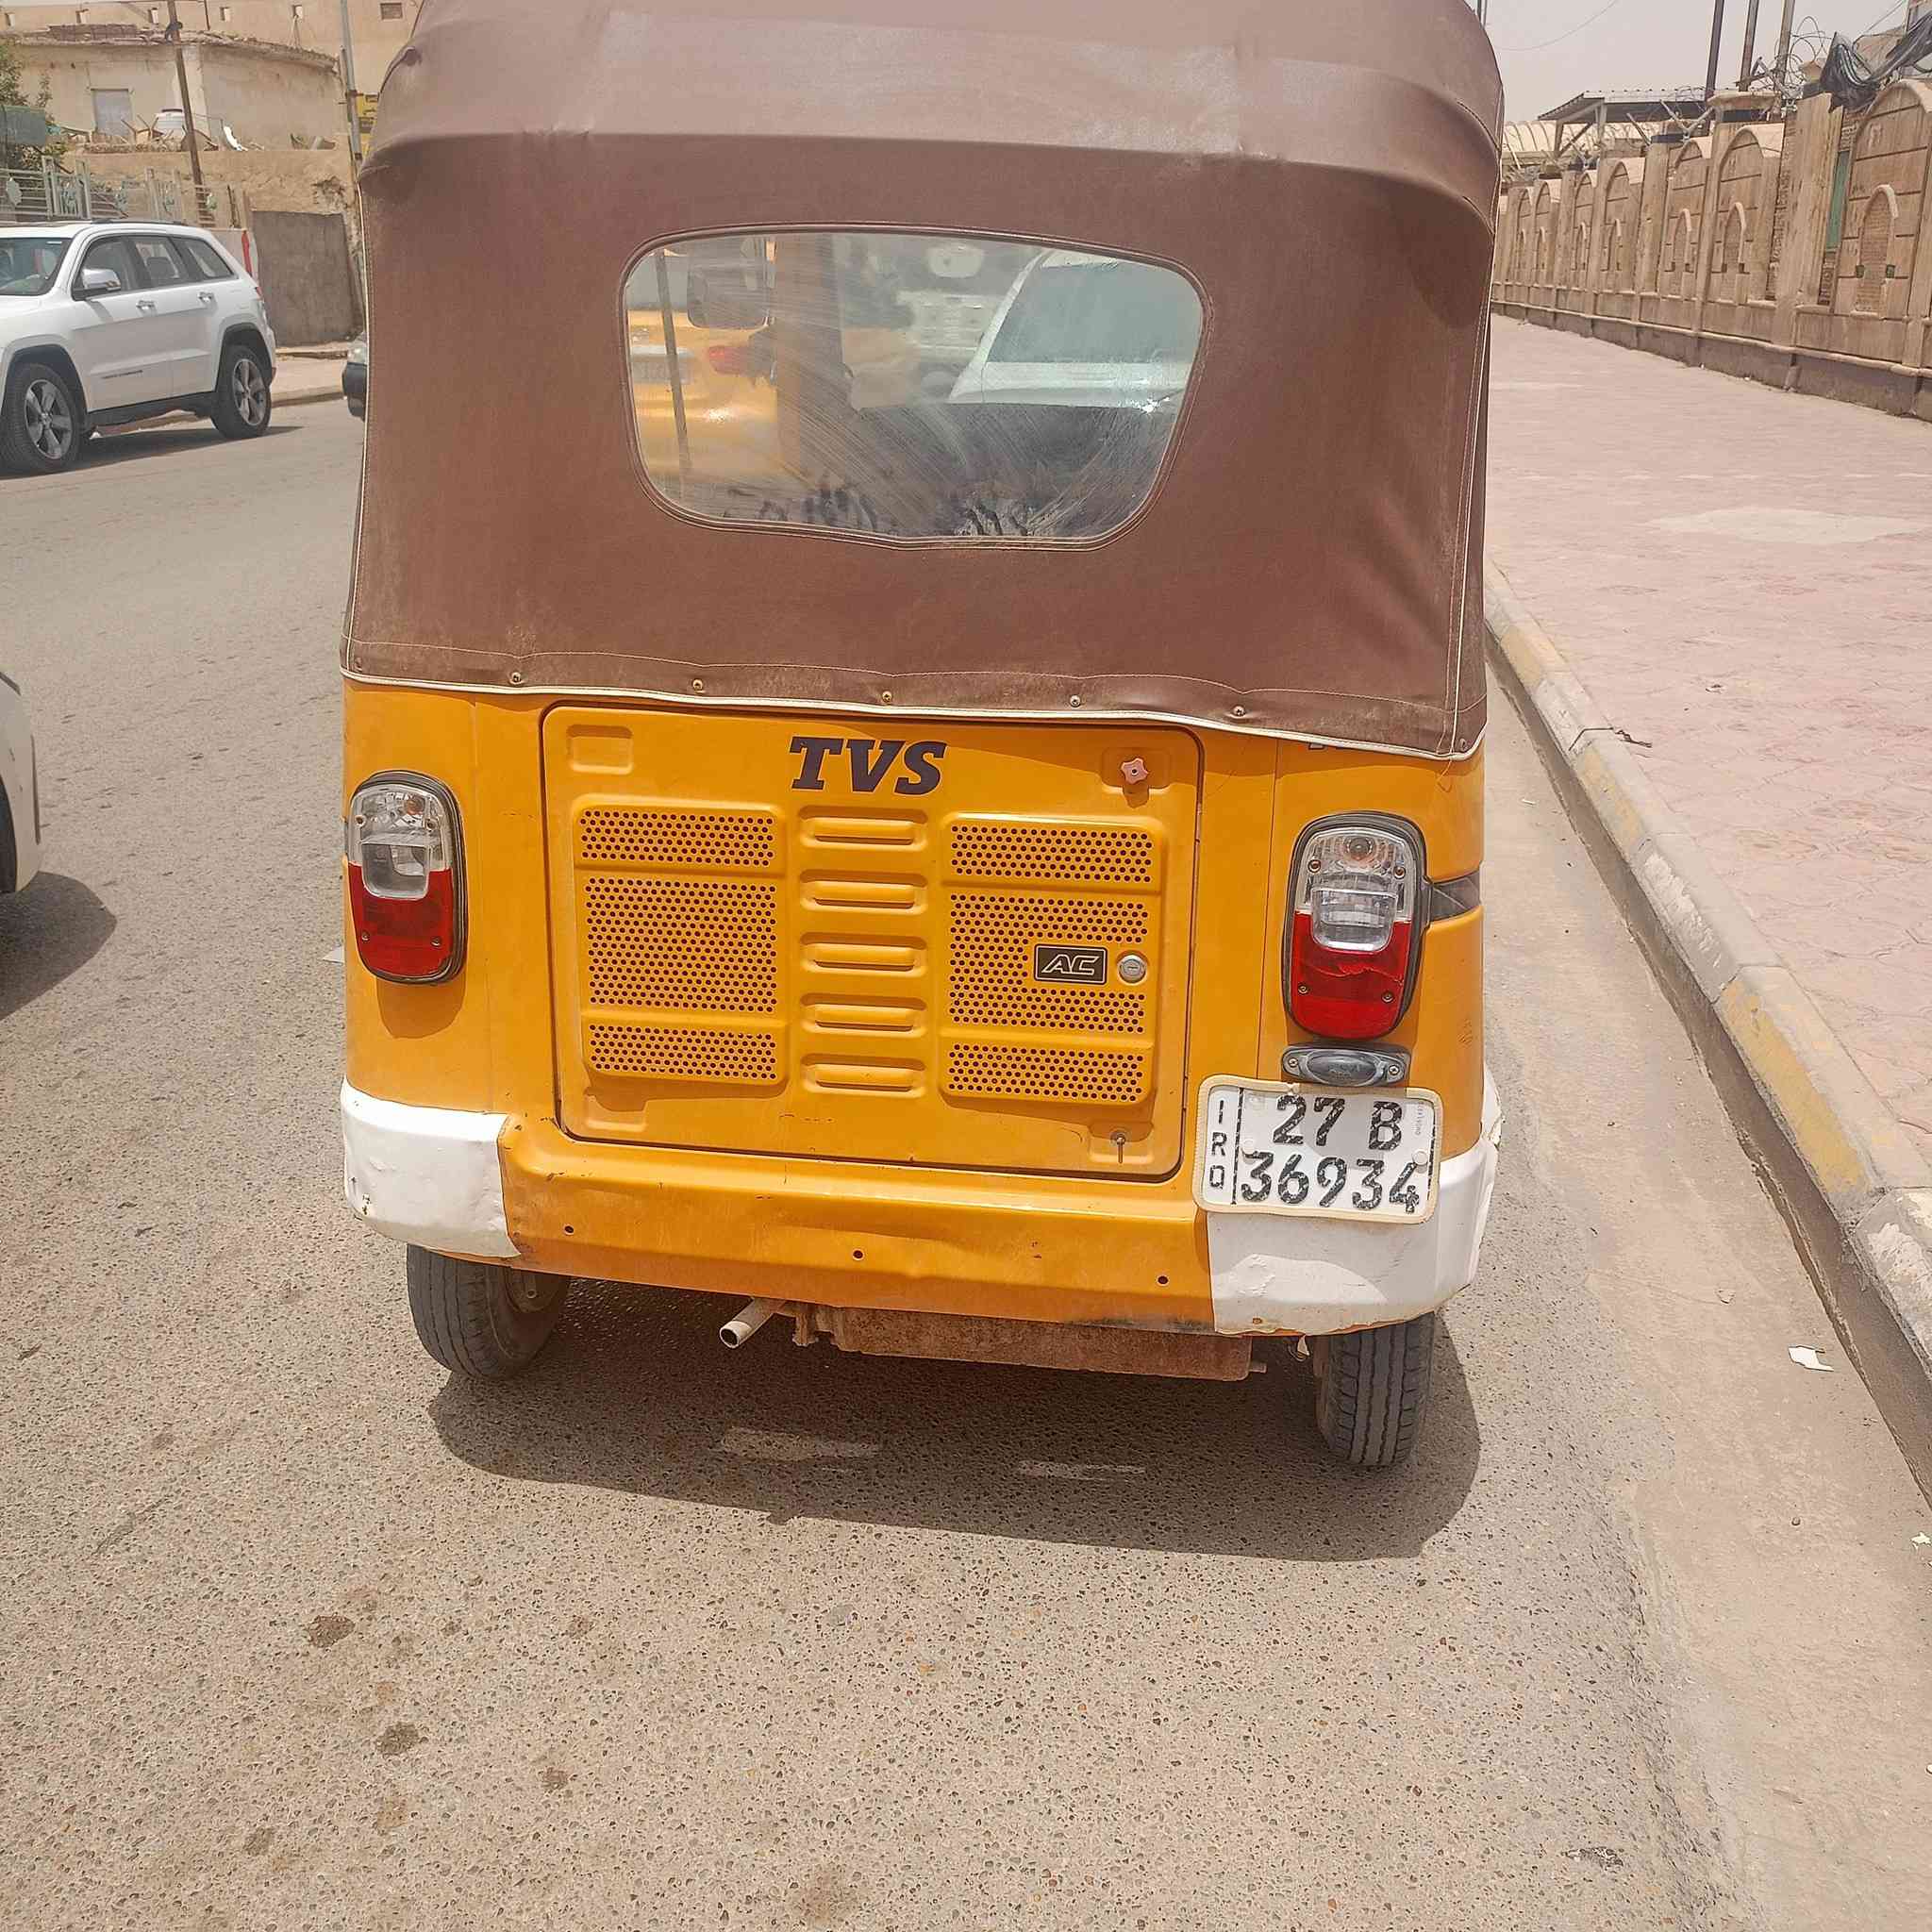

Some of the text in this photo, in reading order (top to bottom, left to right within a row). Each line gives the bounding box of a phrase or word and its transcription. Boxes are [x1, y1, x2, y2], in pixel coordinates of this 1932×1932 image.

[790, 736, 948, 795] TVS
[1041, 953, 1101, 975] AC
[1274, 1094, 1345, 1146] 27
[1369, 1101, 1402, 1151] B
[1241, 1151, 1419, 1214] 36934
